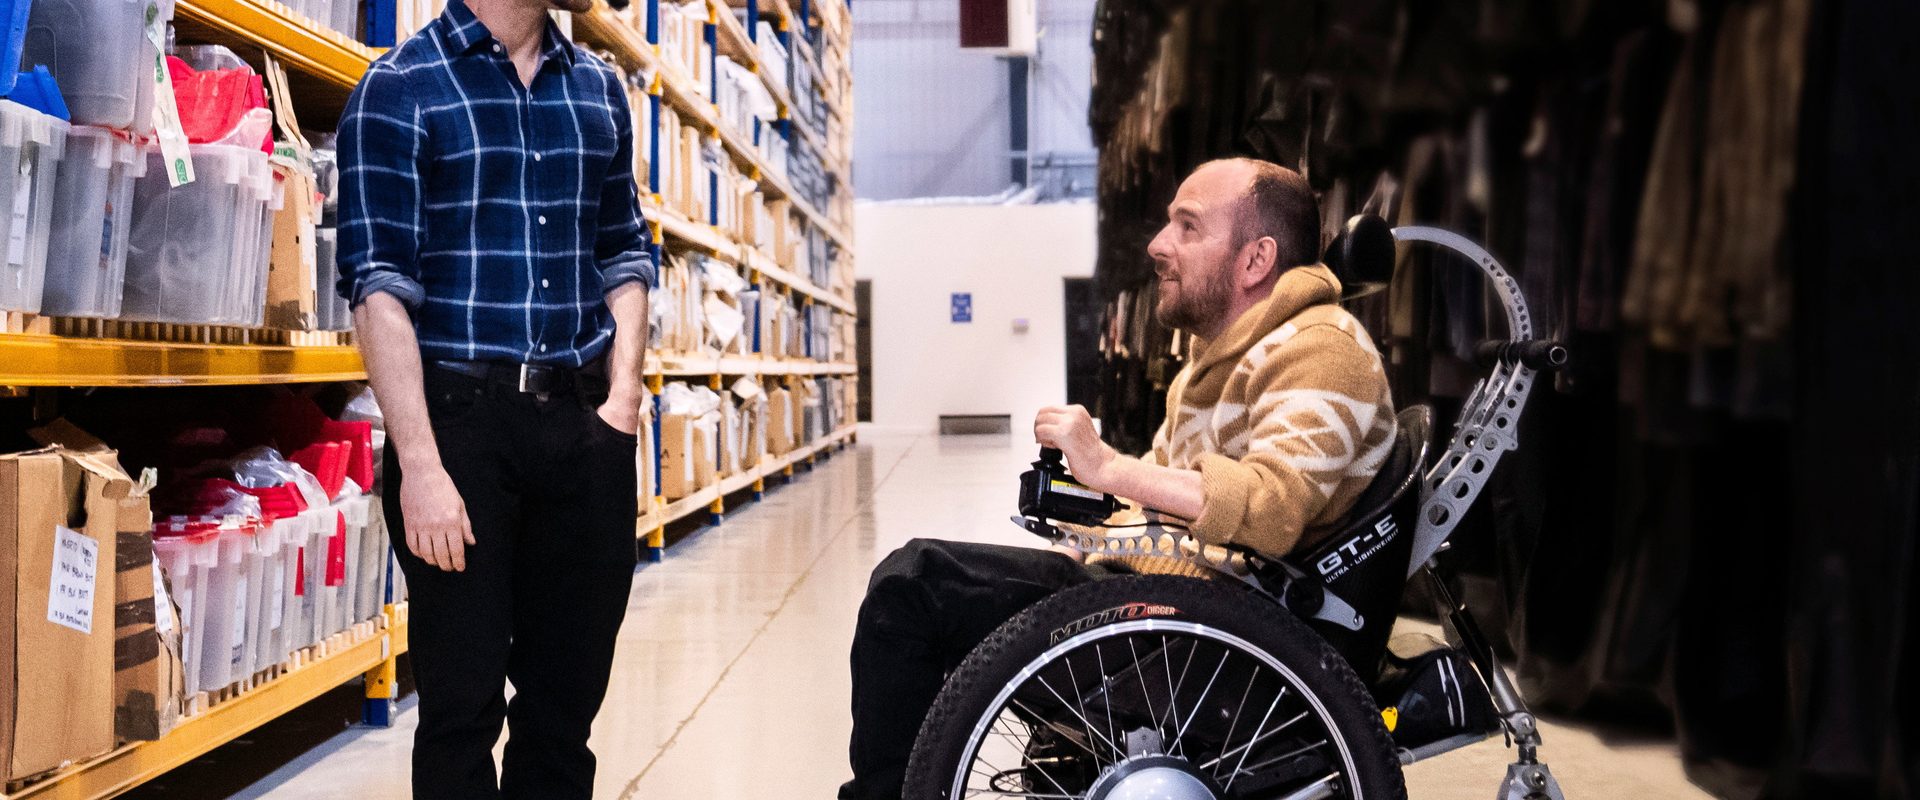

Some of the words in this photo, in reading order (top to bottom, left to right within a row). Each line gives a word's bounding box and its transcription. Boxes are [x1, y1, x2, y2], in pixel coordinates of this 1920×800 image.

[1317, 513, 1396, 575] GT-E
[1326, 565, 1349, 584] ULTRA
[1354, 528, 1399, 565] LIGHTWEIGHT
[1050, 602, 1147, 647] MOTO
[1147, 605, 1176, 615] DIGGER
